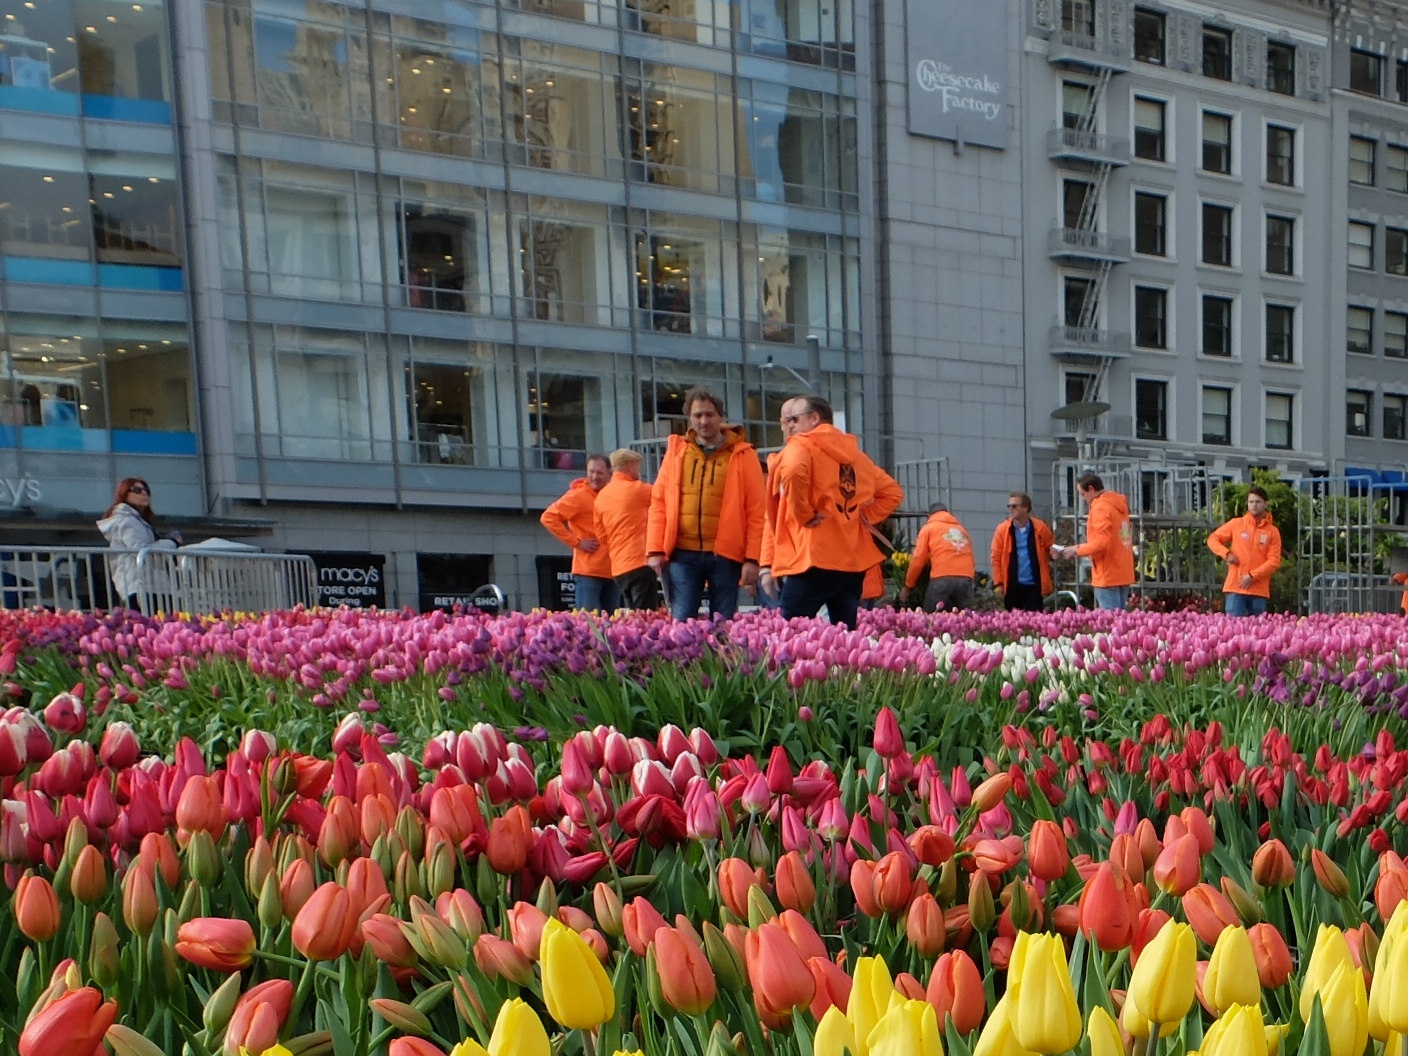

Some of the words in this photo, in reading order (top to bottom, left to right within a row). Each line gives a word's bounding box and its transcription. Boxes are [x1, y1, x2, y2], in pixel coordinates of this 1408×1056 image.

[916, 59, 1000, 93] Cheesecake
[937, 85, 1000, 120] Factory
[0, 472, 41, 506] y's
[320, 565, 379, 585] macy's
[316, 586, 345, 595] TORE
[347, 586, 377, 596] OPEN
[474, 597, 498, 606] SHO
